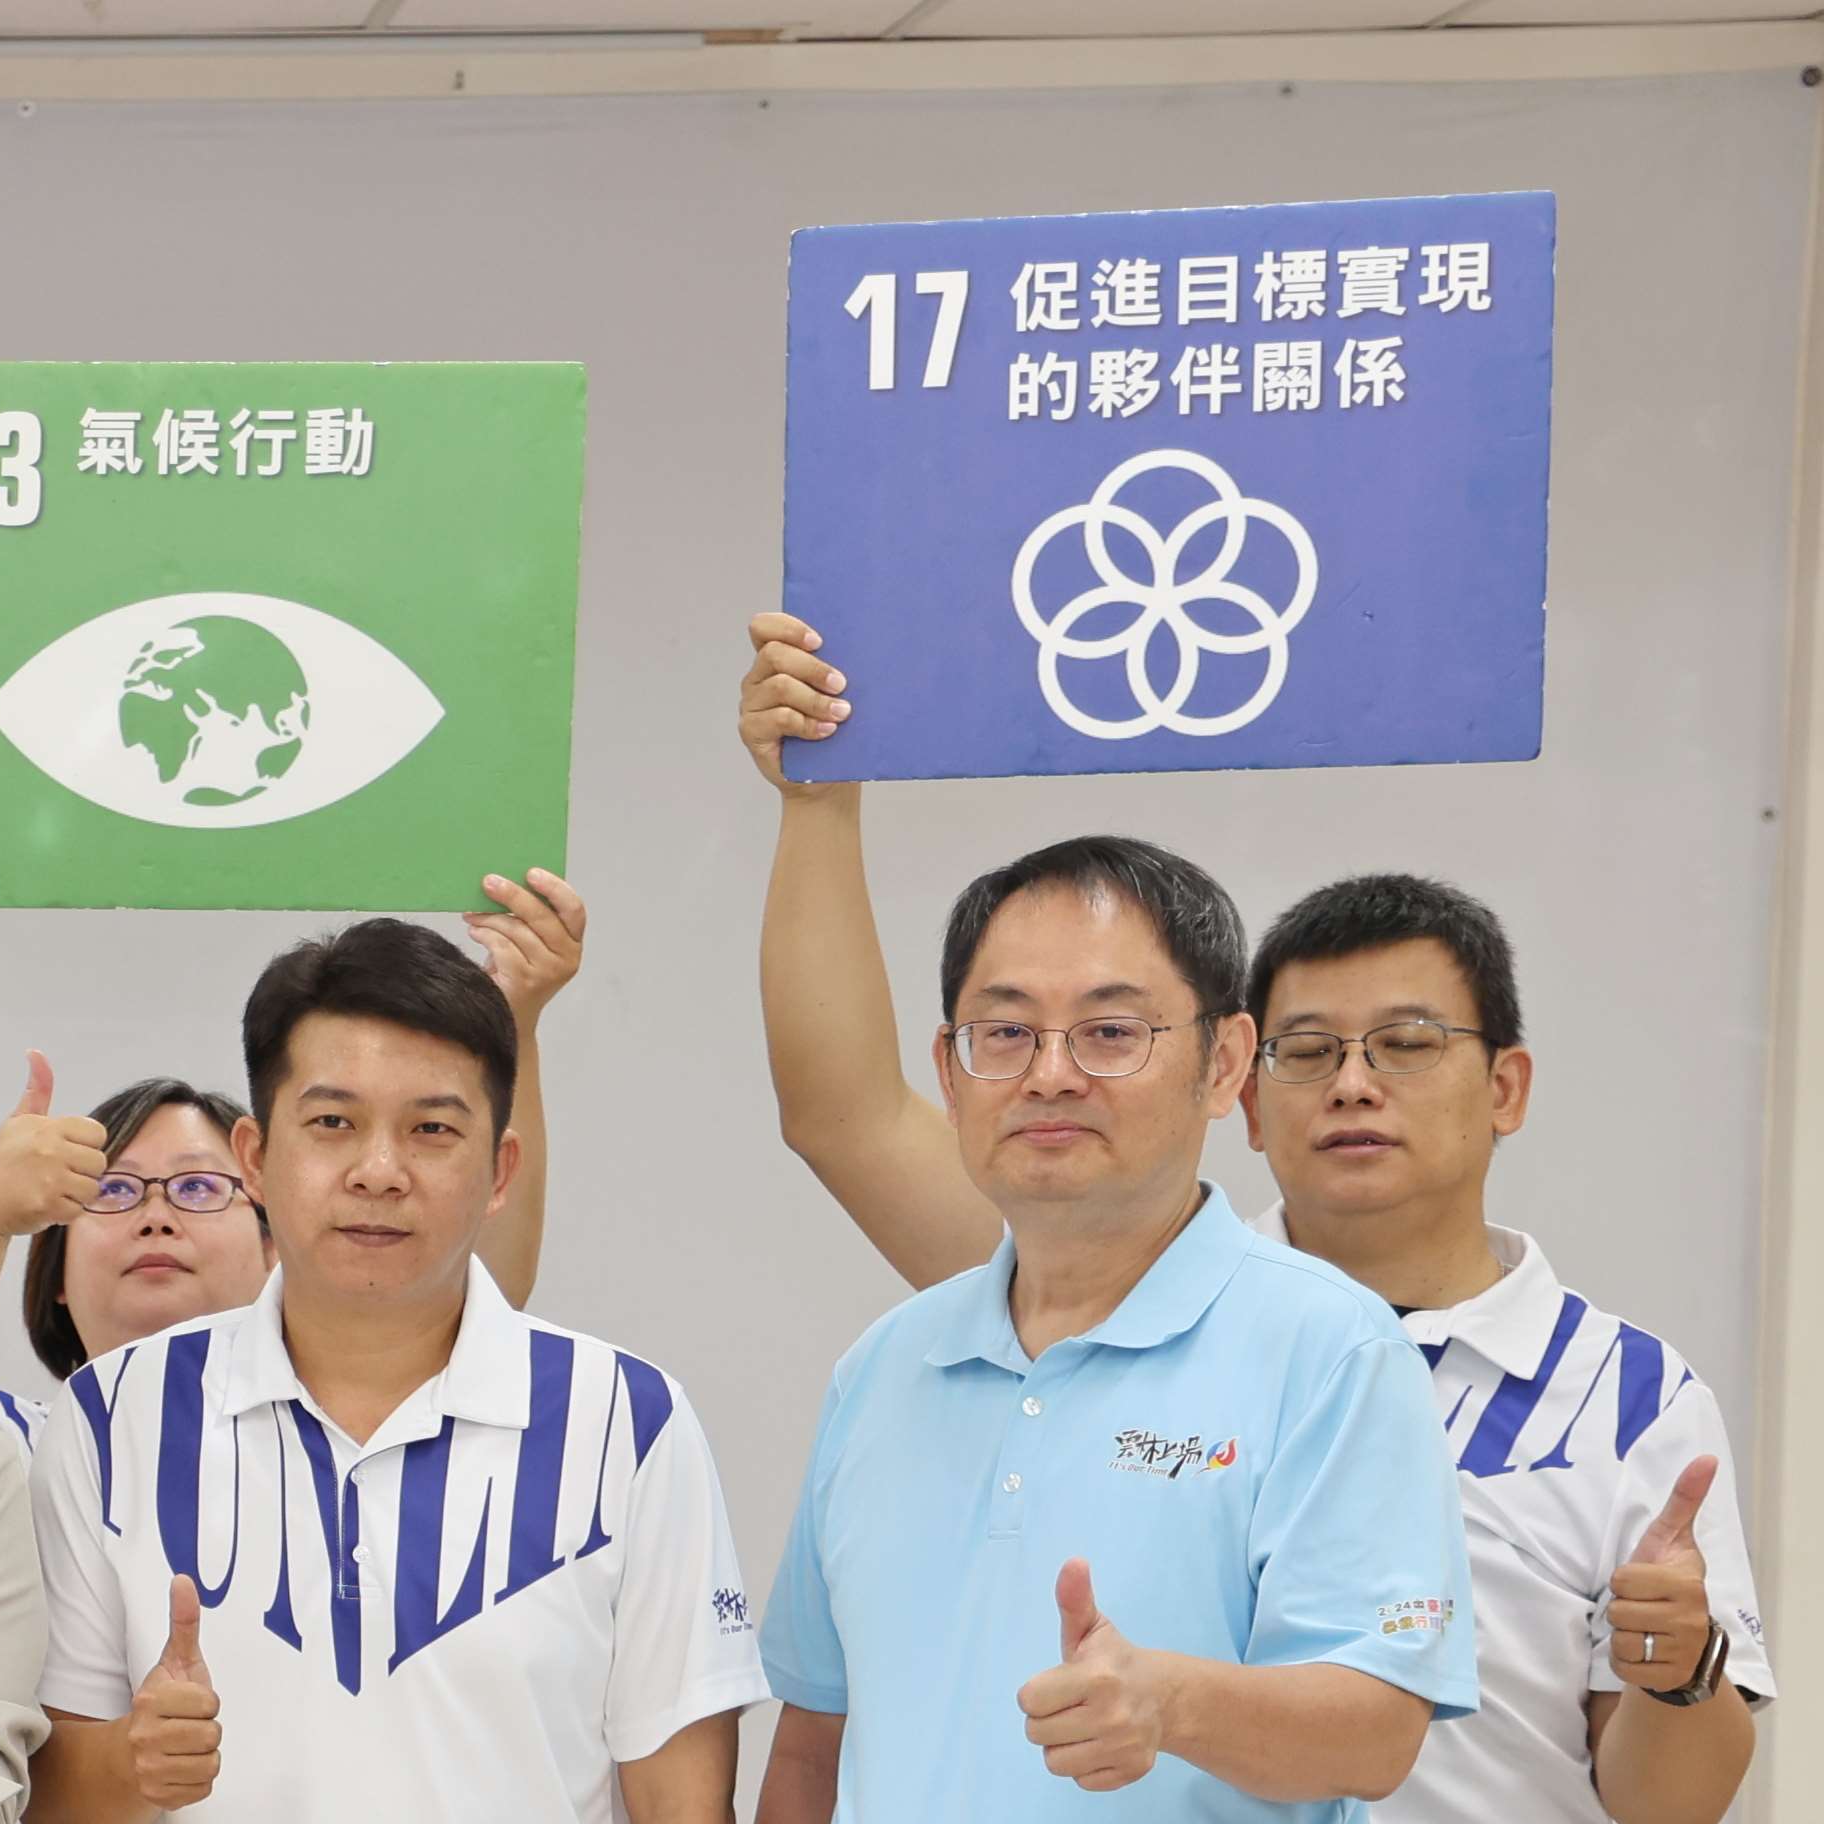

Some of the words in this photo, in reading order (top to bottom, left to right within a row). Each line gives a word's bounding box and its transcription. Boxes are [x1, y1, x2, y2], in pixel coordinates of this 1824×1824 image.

[844, 270, 970, 391] 17
[1009, 242, 1493, 333] 促進目標實現
[1007, 335, 1408, 421] 的夥伴關係
[76, 407, 374, 477] 氣候行動
